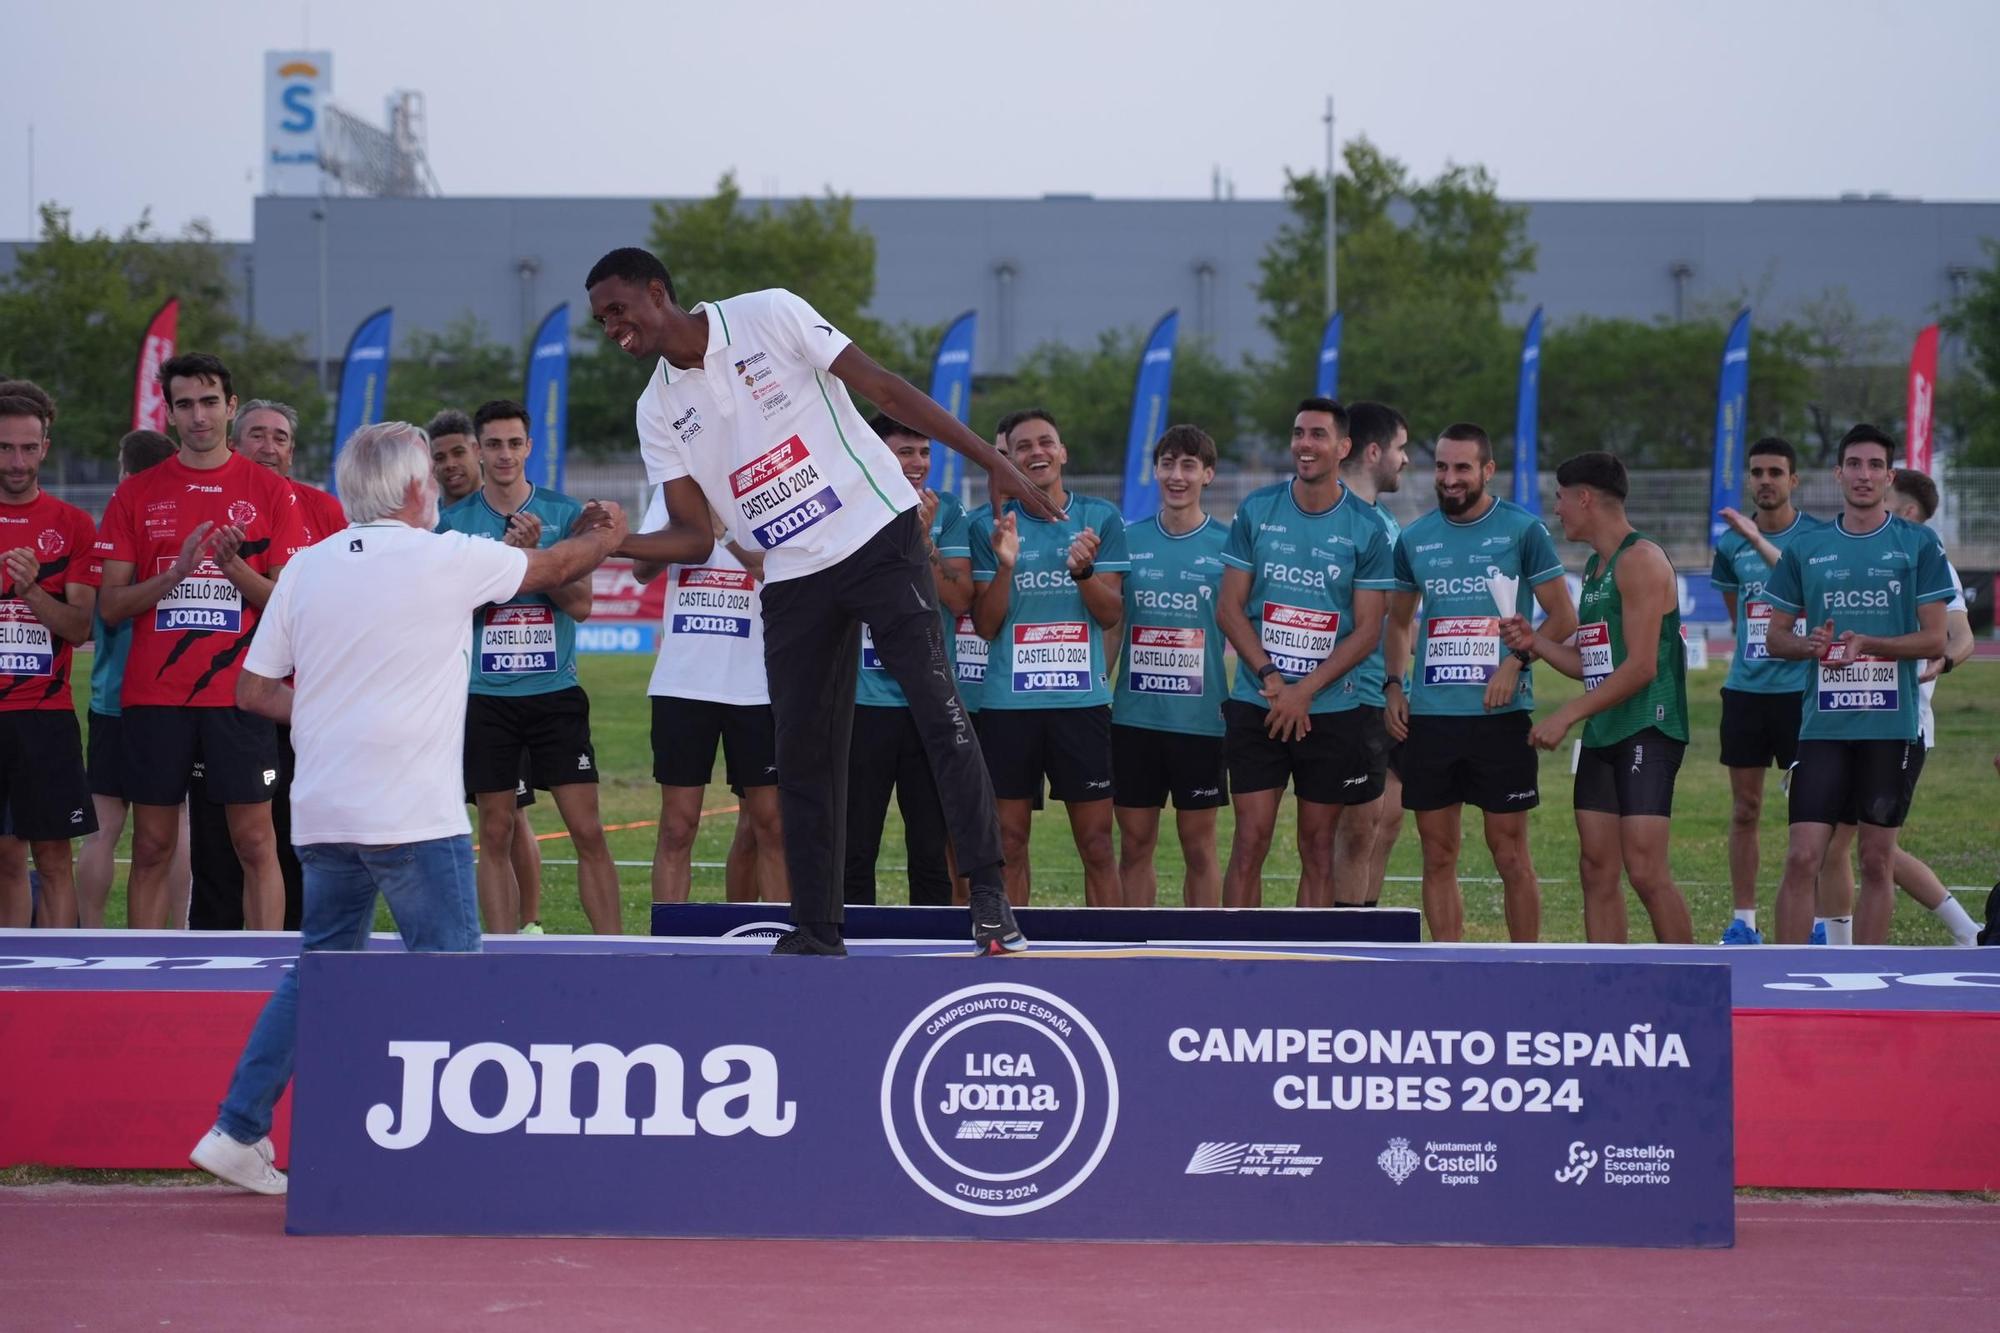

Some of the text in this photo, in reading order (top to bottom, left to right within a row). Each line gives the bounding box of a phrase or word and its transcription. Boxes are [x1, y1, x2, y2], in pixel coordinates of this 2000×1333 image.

[742, 464, 819, 520] CASTELLÓ 2024
[764, 500, 826, 545] Joma
[1014, 570, 1077, 592] Facsa
[1263, 562, 1326, 589] Facsa
[214, 585, 237, 601] 2024
[1425, 576, 1487, 596] Facsa
[679, 590, 750, 611] CASTELLÓ 2024
[1134, 590, 1198, 611] Facsa
[1823, 589, 1888, 609] Facsa
[167, 610, 227, 627] Joma
[682, 615, 739, 633] Joma
[26, 629, 47, 646] 2024
[486, 626, 552, 645] CASTELLÓ 2024
[1750, 623, 1768, 636] CASTE
[579, 627, 640, 651] NDO
[1264, 628, 1331, 651] CASTELLÓ 2024
[1429, 637, 1495, 657] CASTELLÓ 2024
[492, 654, 547, 671] Joma
[1017, 644, 1087, 664] CASTELLÓ 2024
[1133, 650, 1200, 668] CASTELLÓ 2024
[1592, 650, 1609, 666] 2024
[1024, 673, 1079, 690] Joma
[1433, 665, 1486, 681] Joma
[1822, 664, 1893, 683] CASTELLÓ 2024
[1138, 676, 1190, 692] Joma
[1830, 691, 1886, 709] Joma
[946, 696, 969, 744] PUMA
[926, 998, 1072, 1038] CAMPEONATO DE ESPAÑA
[1168, 1023, 1690, 1068] CAMPEONATO ESPAÑA
[965, 1053, 1036, 1077] LIGA
[365, 1040, 797, 1150] Joma
[940, 1083, 1059, 1114] Joma
[1273, 1075, 1583, 1112] CLUBES 2024
[989, 1120, 1044, 1134] RFEA
[1249, 1143, 1301, 1157] RFEA
[1425, 1142, 1497, 1153] Ajuntament de
[1604, 1145, 1675, 1159] Castellón
[1243, 1156, 1323, 1165] ATLETISMO
[1424, 1153, 1497, 1172] Castelló
[1604, 1159, 1670, 1172] Escenario
[1239, 1167, 1314, 1177] AIRE LIBRE
[1441, 1174, 1479, 1186] Esports
[1604, 1172, 1670, 1186] Deportivo
[956, 1182, 1038, 1200] CLUBES 2024
